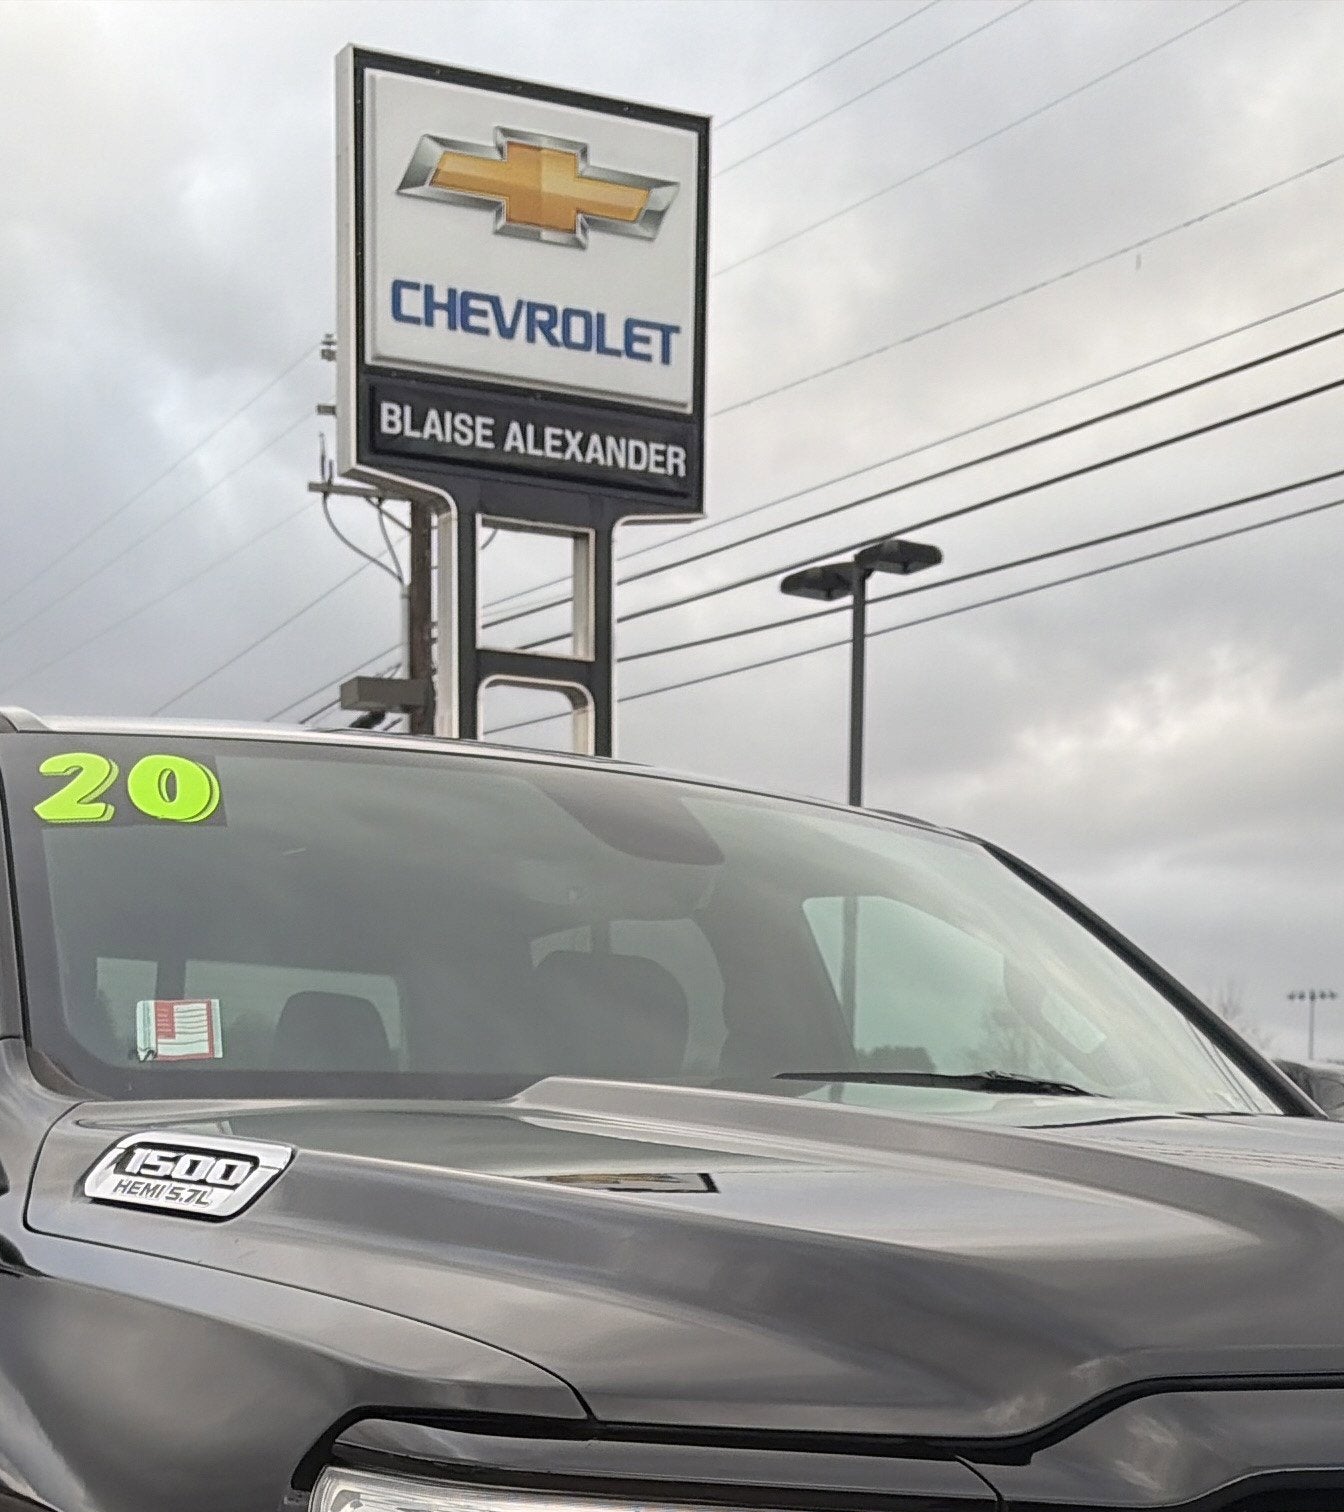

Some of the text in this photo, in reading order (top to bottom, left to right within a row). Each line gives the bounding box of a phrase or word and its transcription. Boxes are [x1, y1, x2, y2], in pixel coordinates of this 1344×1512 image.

[390, 278, 681, 366] CHEVROLET
[379, 401, 687, 478] BLAISE ALEXANDER
[33, 752, 220, 823] 20
[113, 1179, 210, 1206] HEMI 5.7L
[124, 1149, 253, 1186] 1500
